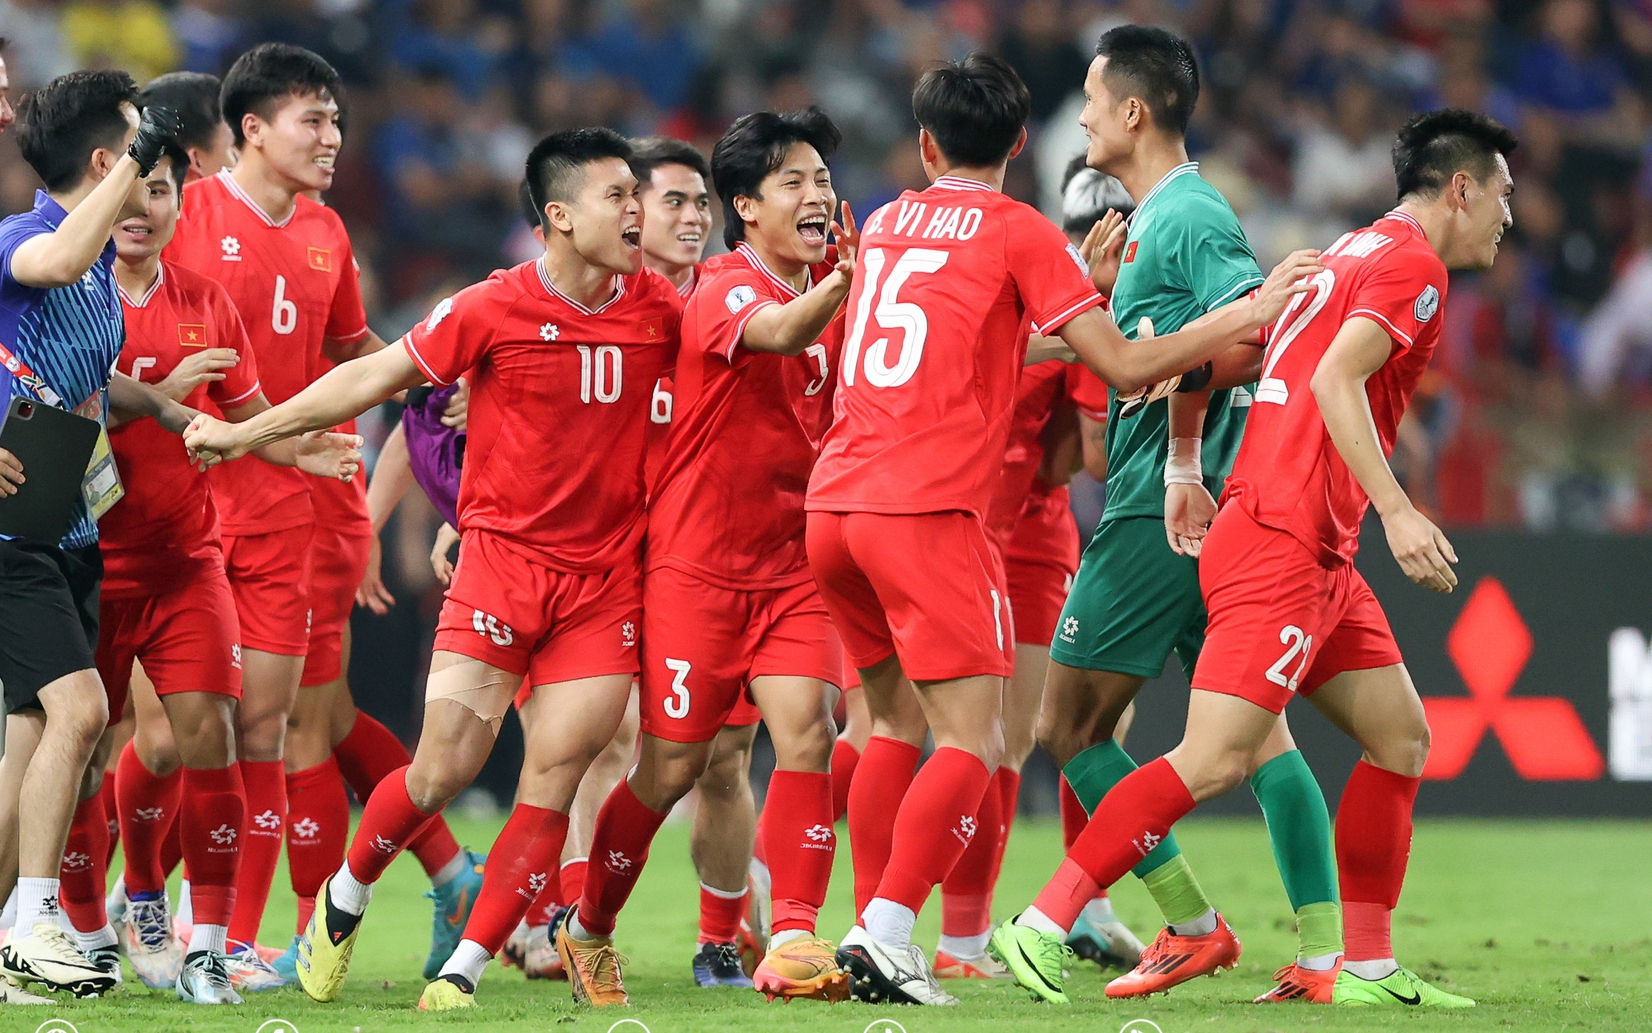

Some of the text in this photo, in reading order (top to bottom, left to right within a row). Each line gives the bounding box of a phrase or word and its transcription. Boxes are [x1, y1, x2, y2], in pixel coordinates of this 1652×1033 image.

[893, 200, 927, 237] VI
[922, 206, 983, 241] HAO
[271, 274, 298, 335] 6
[843, 247, 949, 387] 15
[577, 344, 623, 404] 10
[663, 657, 691, 719] 3
